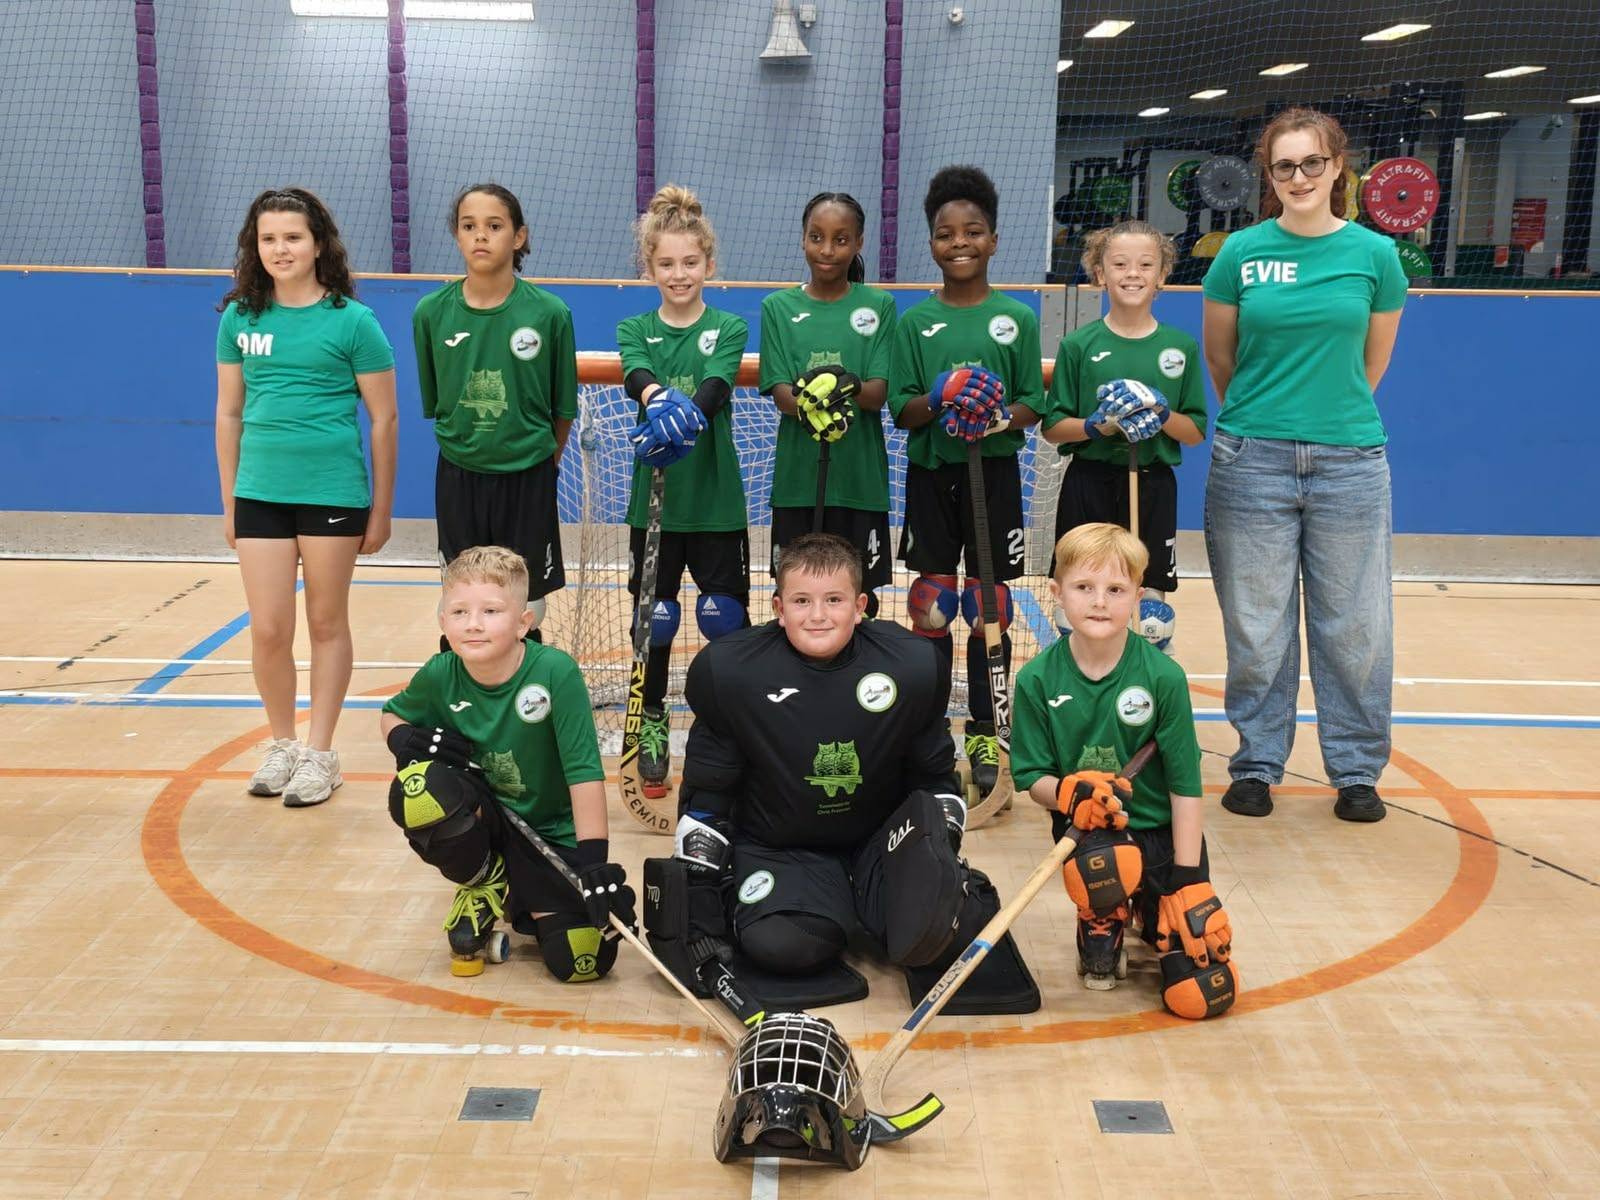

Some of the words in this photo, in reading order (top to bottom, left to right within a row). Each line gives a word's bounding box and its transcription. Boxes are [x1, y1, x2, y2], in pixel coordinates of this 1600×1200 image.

[1241, 261, 1299, 286] EVIE
[867, 529, 880, 555] 4
[1007, 528, 1025, 555] 2
